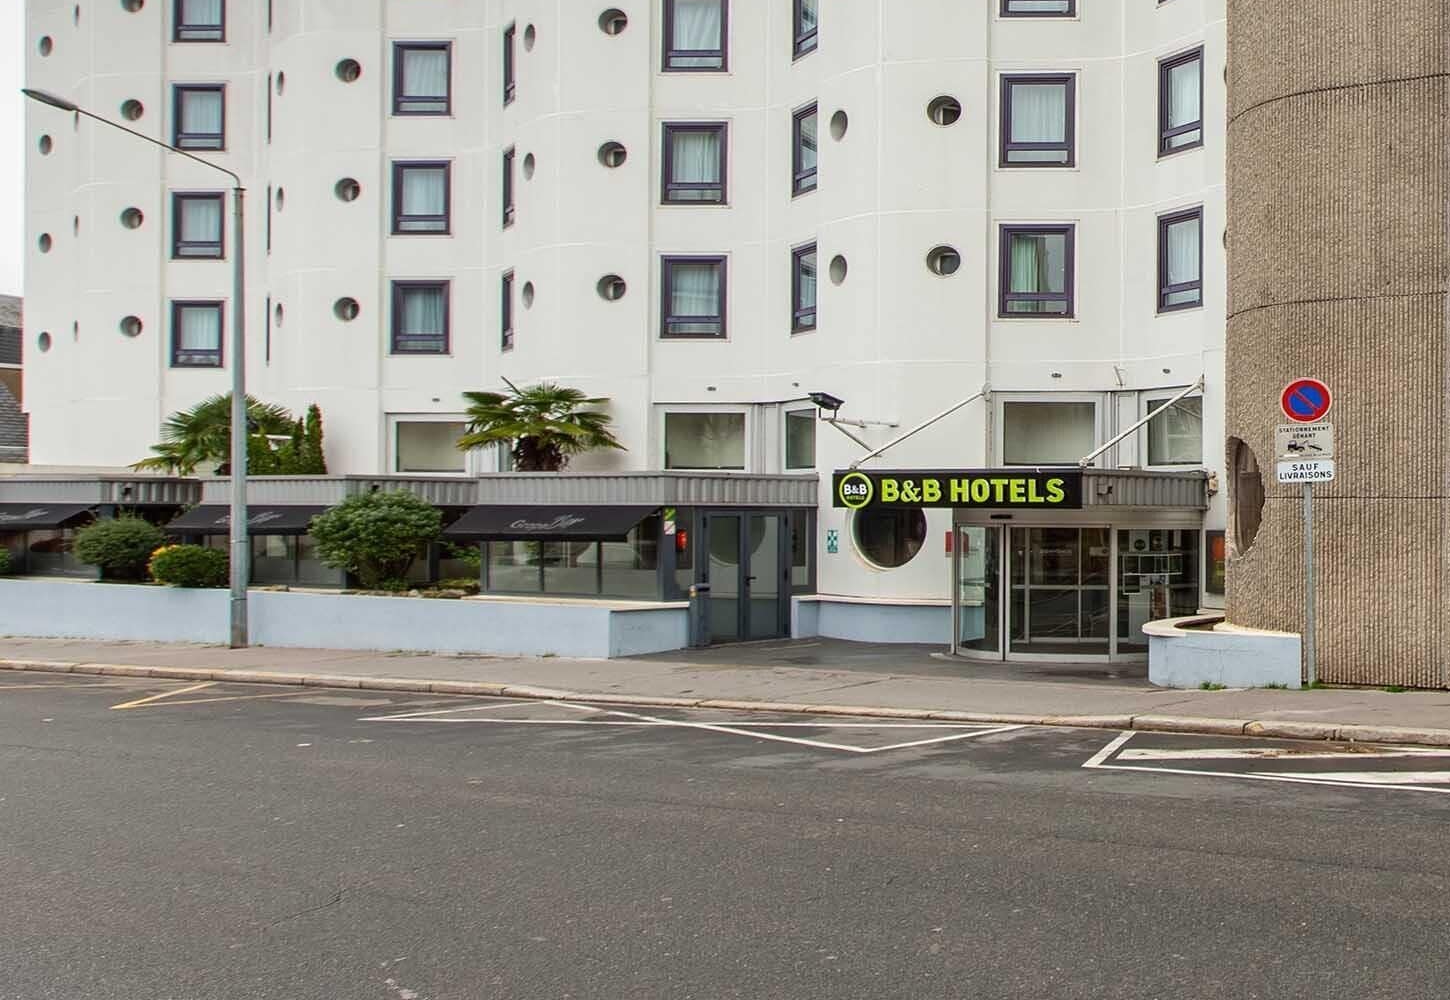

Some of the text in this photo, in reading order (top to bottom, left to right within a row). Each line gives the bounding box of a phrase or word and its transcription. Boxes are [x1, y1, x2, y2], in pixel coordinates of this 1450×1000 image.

[1292, 463, 1319, 471] SAUF
[1279, 471, 1332, 480] LIVRAISONS
[844, 484, 867, 495] B&B
[881, 479, 1065, 503] B&B HOTELS
